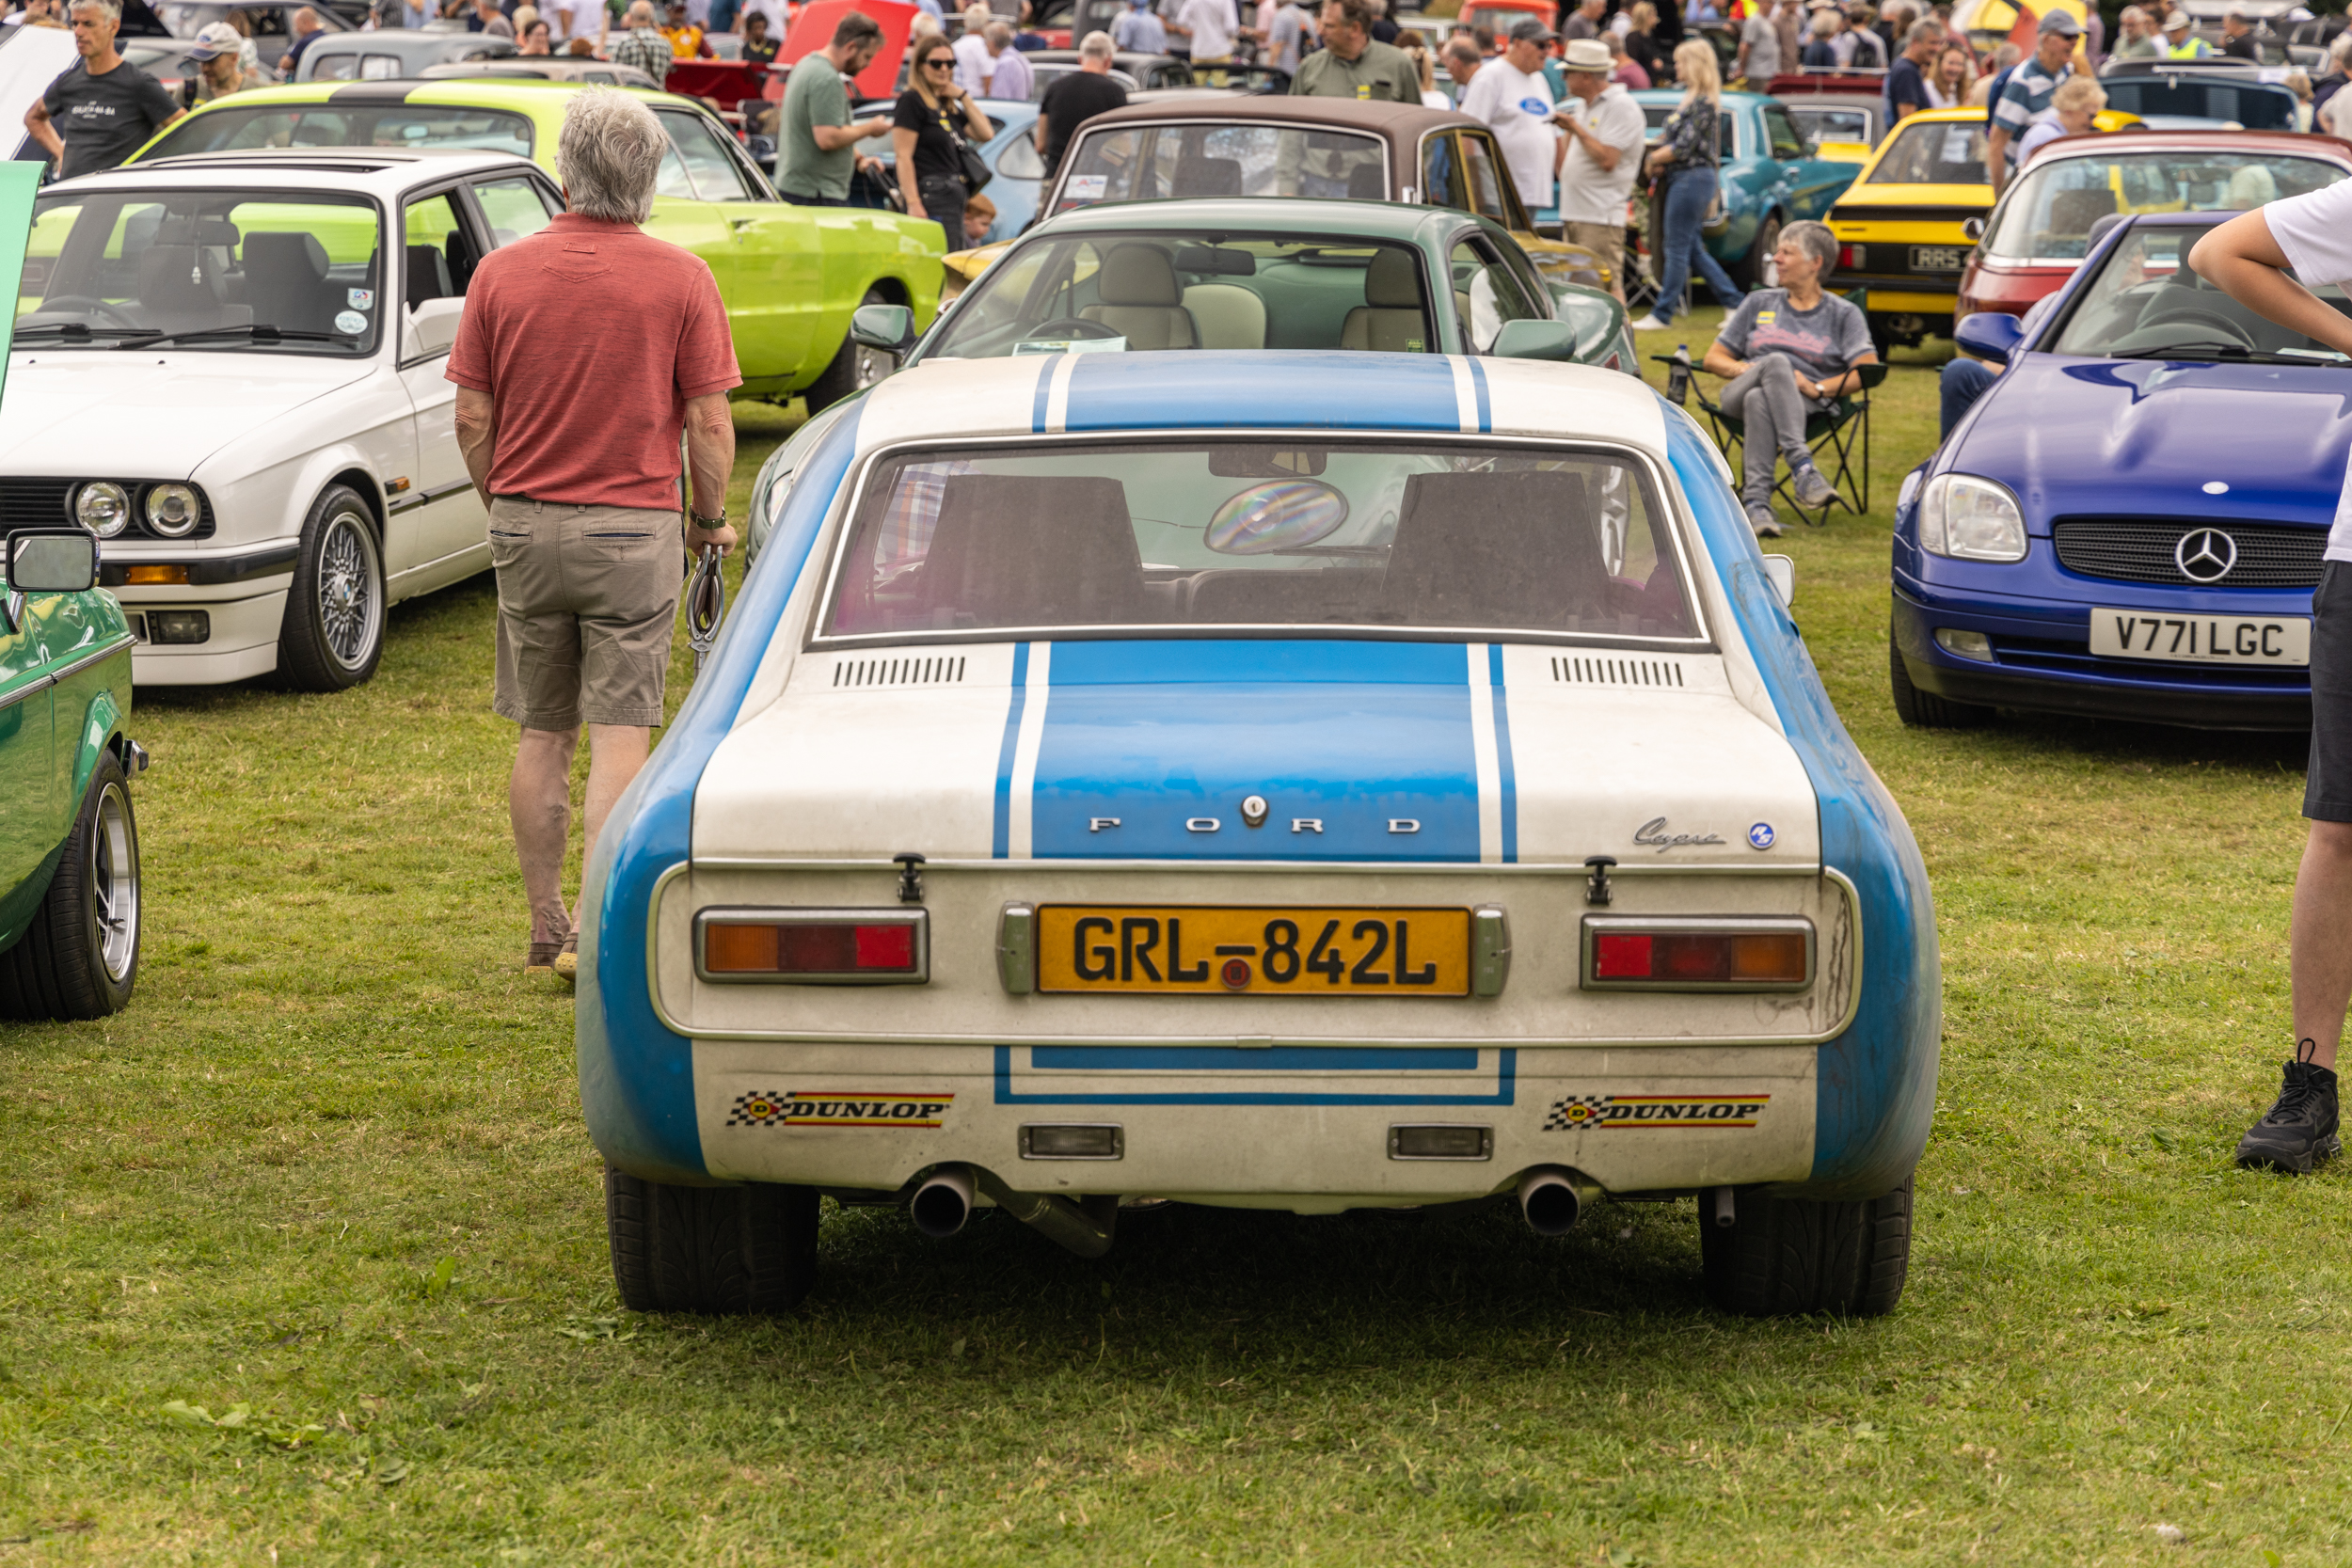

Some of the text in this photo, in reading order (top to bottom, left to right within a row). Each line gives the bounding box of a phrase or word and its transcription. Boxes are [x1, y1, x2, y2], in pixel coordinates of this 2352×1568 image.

[1918, 248, 1961, 268] RRS
[2116, 616, 2283, 657] V771 LGC
[1089, 816, 1422, 833] FORD
[1632, 815, 1727, 853] Capri
[1750, 825, 1773, 844] RS
[1073, 915, 1437, 985] GRL-842L
[787, 1101, 944, 1118] DUNLOP
[1605, 1103, 1761, 1119] DUNLOP
